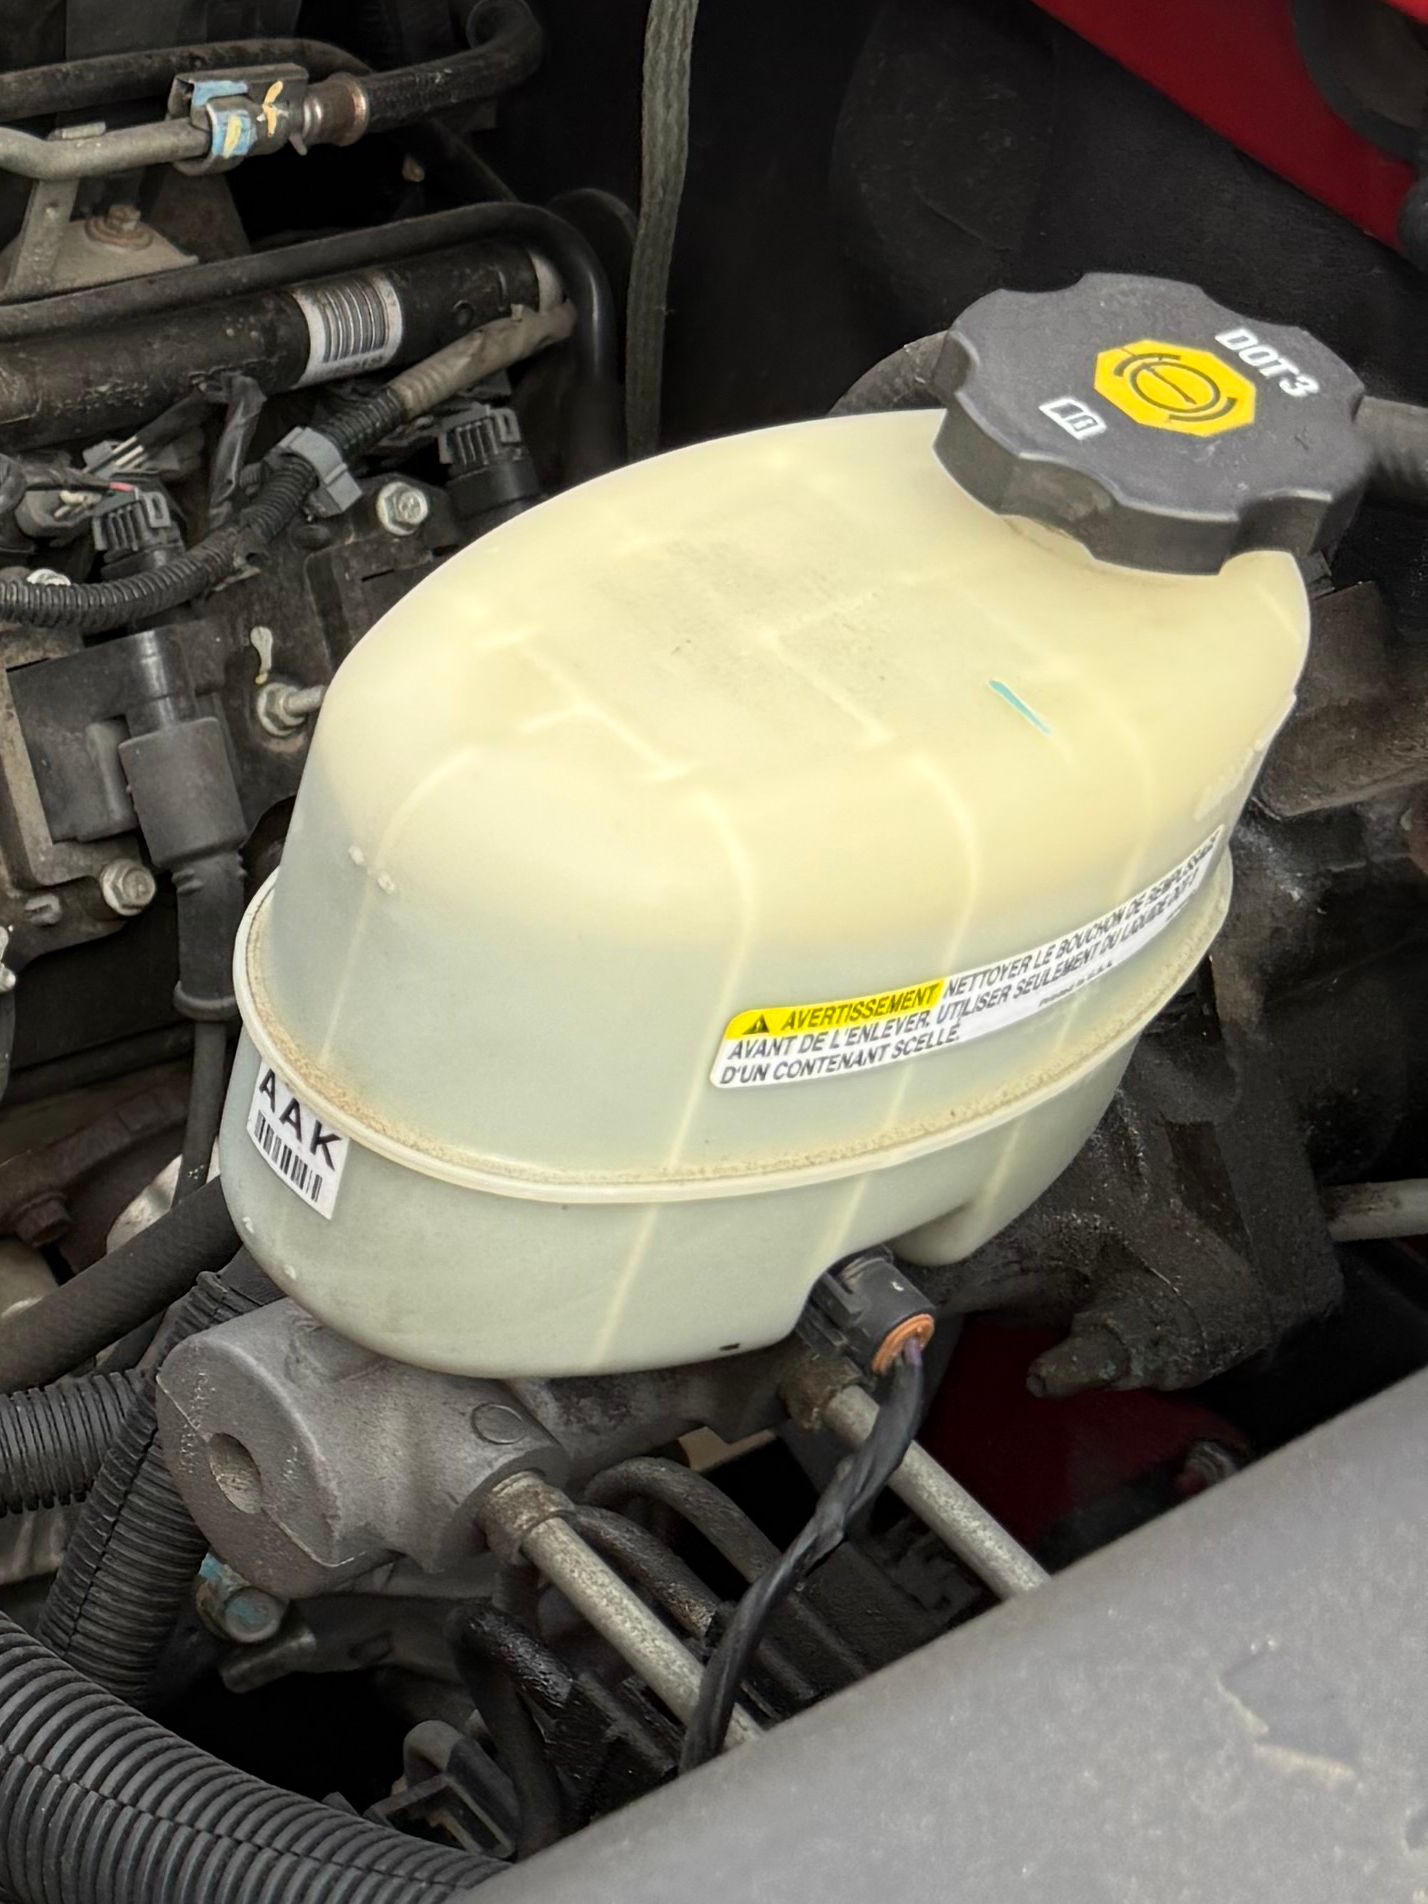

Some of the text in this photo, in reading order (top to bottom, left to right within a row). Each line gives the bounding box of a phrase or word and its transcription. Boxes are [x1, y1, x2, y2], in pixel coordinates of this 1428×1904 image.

[941, 955, 1034, 998] NETTOYER
[1030, 946, 1056, 969] LE
[1053, 909, 1124, 957] BOUCHON
[1120, 896, 1146, 919] DE
[727, 1031, 792, 1067] AVANT
[795, 1031, 825, 1054] DE
[830, 1010, 926, 1050] L'ENLEVER.
[933, 987, 1009, 1023] UTILISER
[1011, 943, 1096, 1000] SEULEMENT
[1093, 931, 1120, 954] DU
[784, 978, 938, 1036] AVERTISSEMENT
[719, 1058, 768, 1087] D'UN
[774, 1040, 882, 1085] CONTENANT
[258, 1071, 341, 1172] AAK
